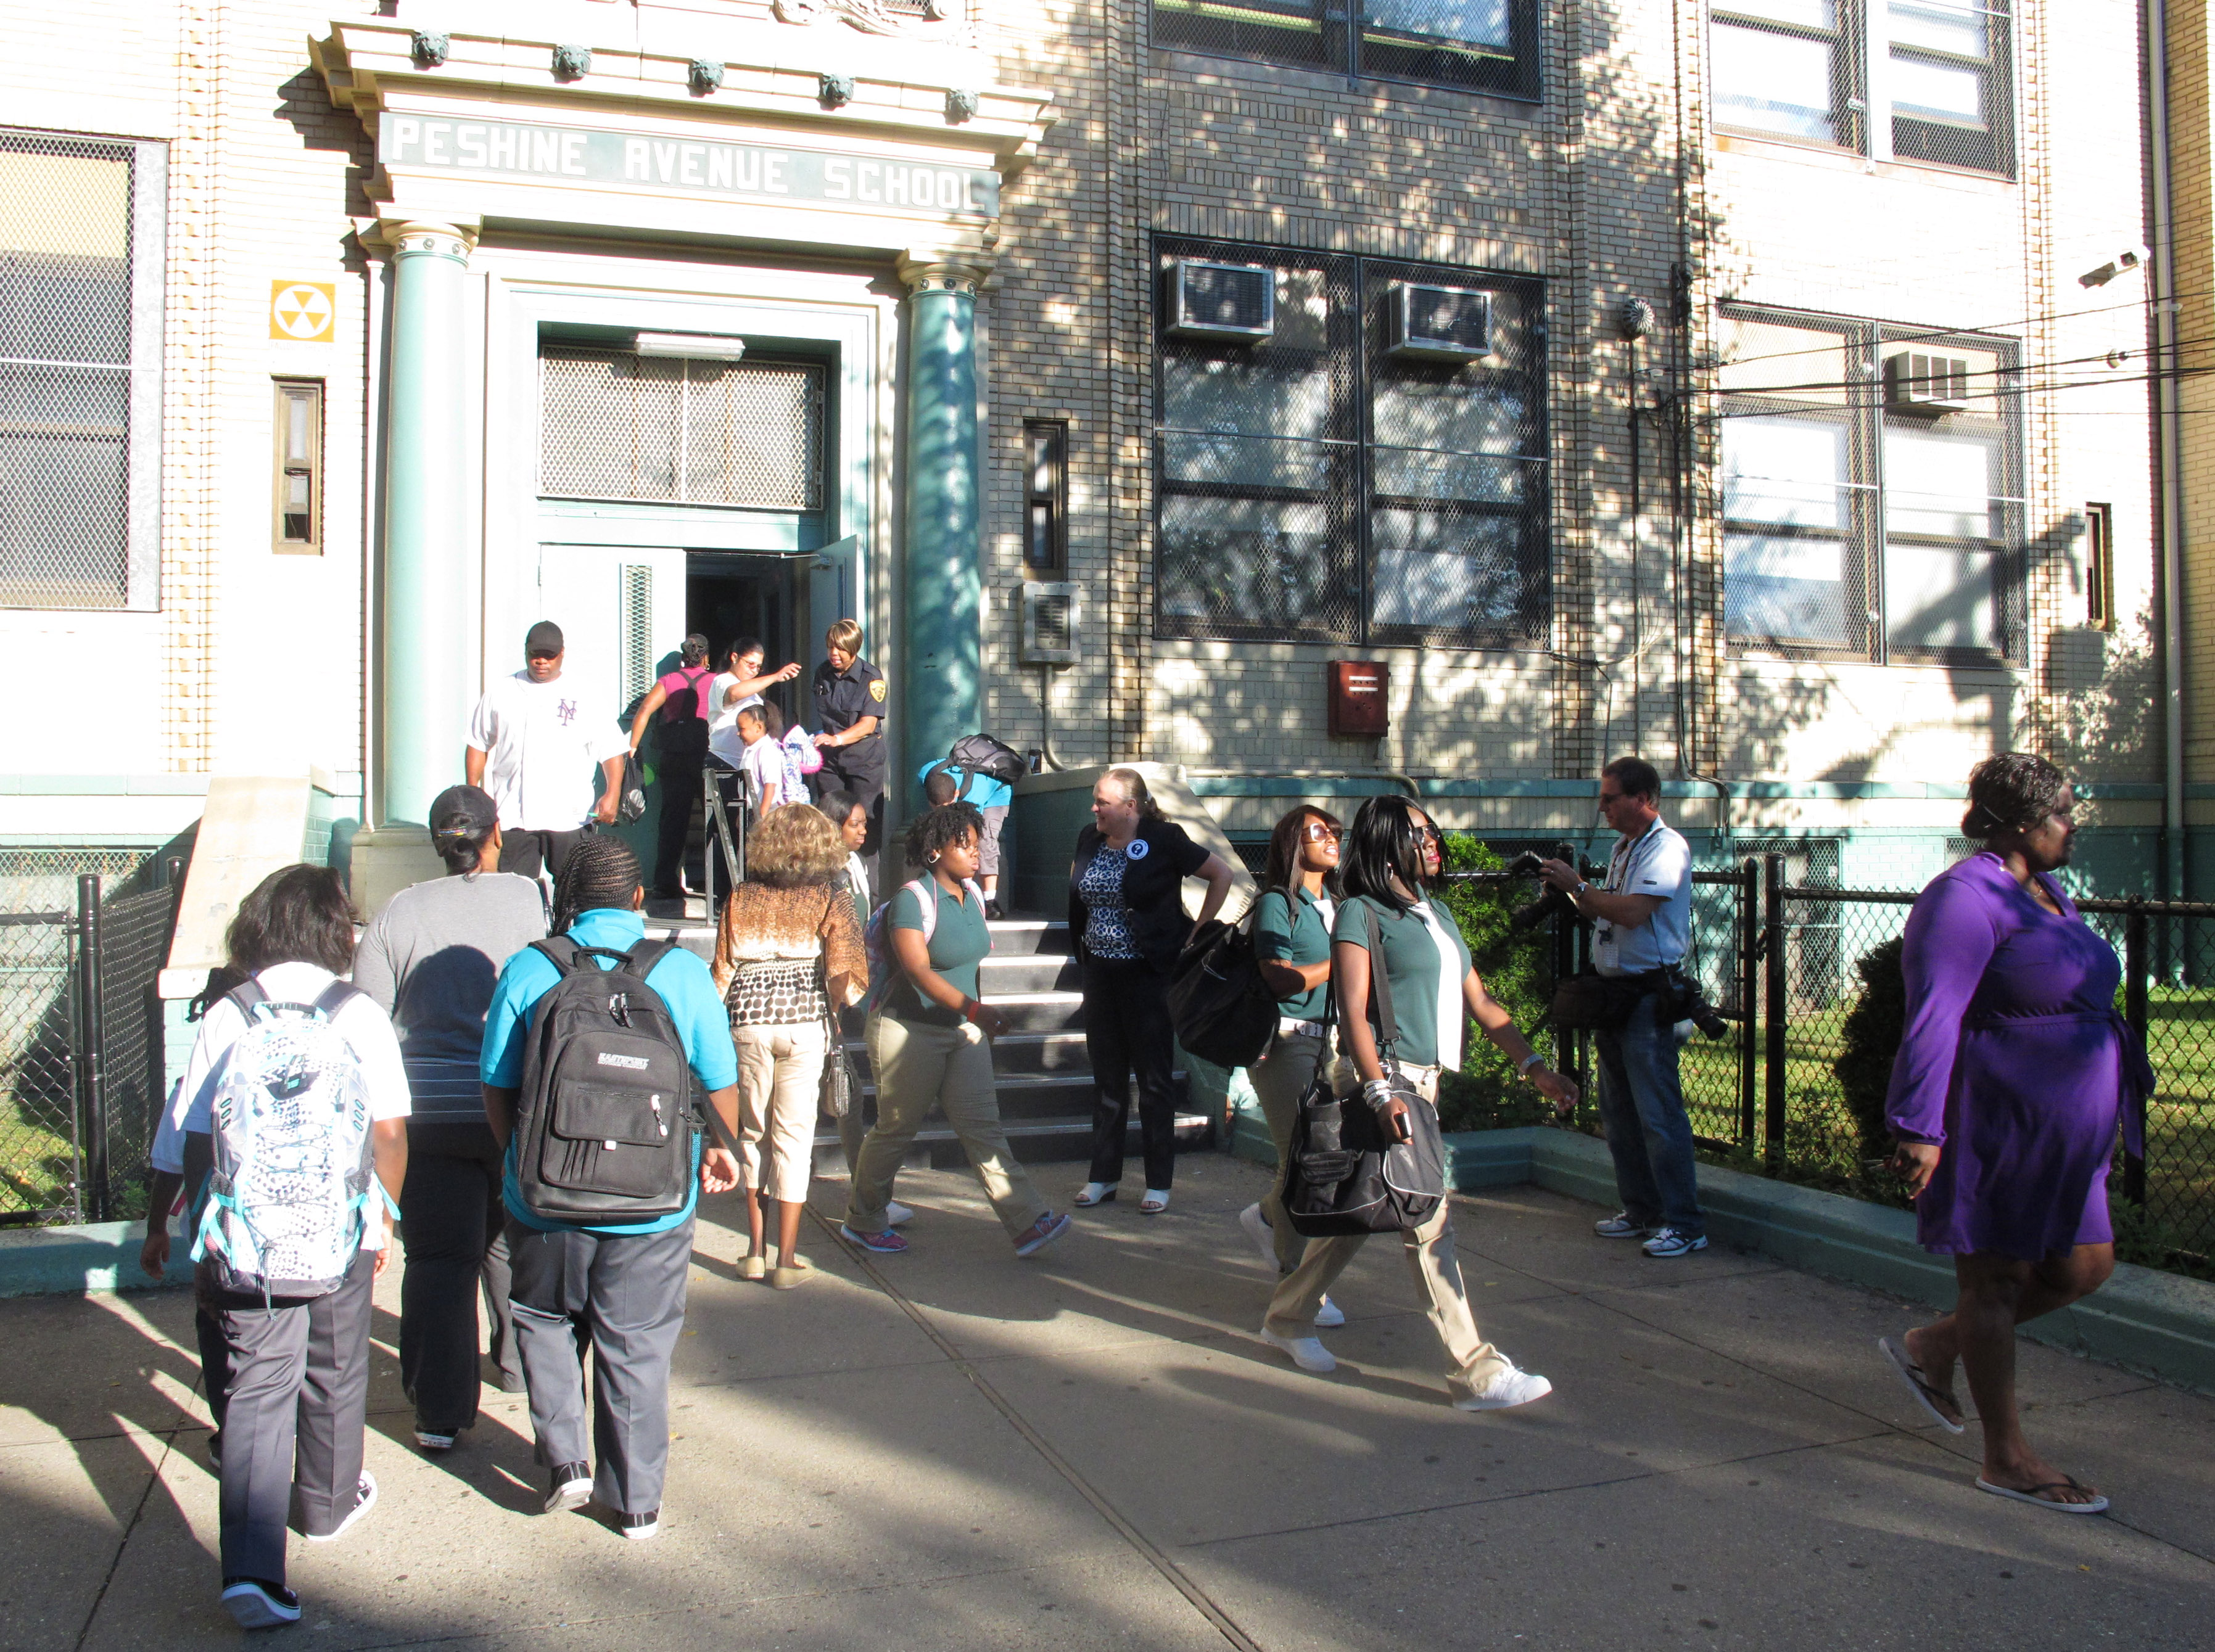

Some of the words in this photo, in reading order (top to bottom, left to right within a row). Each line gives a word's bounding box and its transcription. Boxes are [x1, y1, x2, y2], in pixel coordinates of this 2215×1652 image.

[392, 118, 587, 176] PESHINE
[625, 138, 789, 194] AVENUE
[824, 158, 985, 212] SCHOOL
